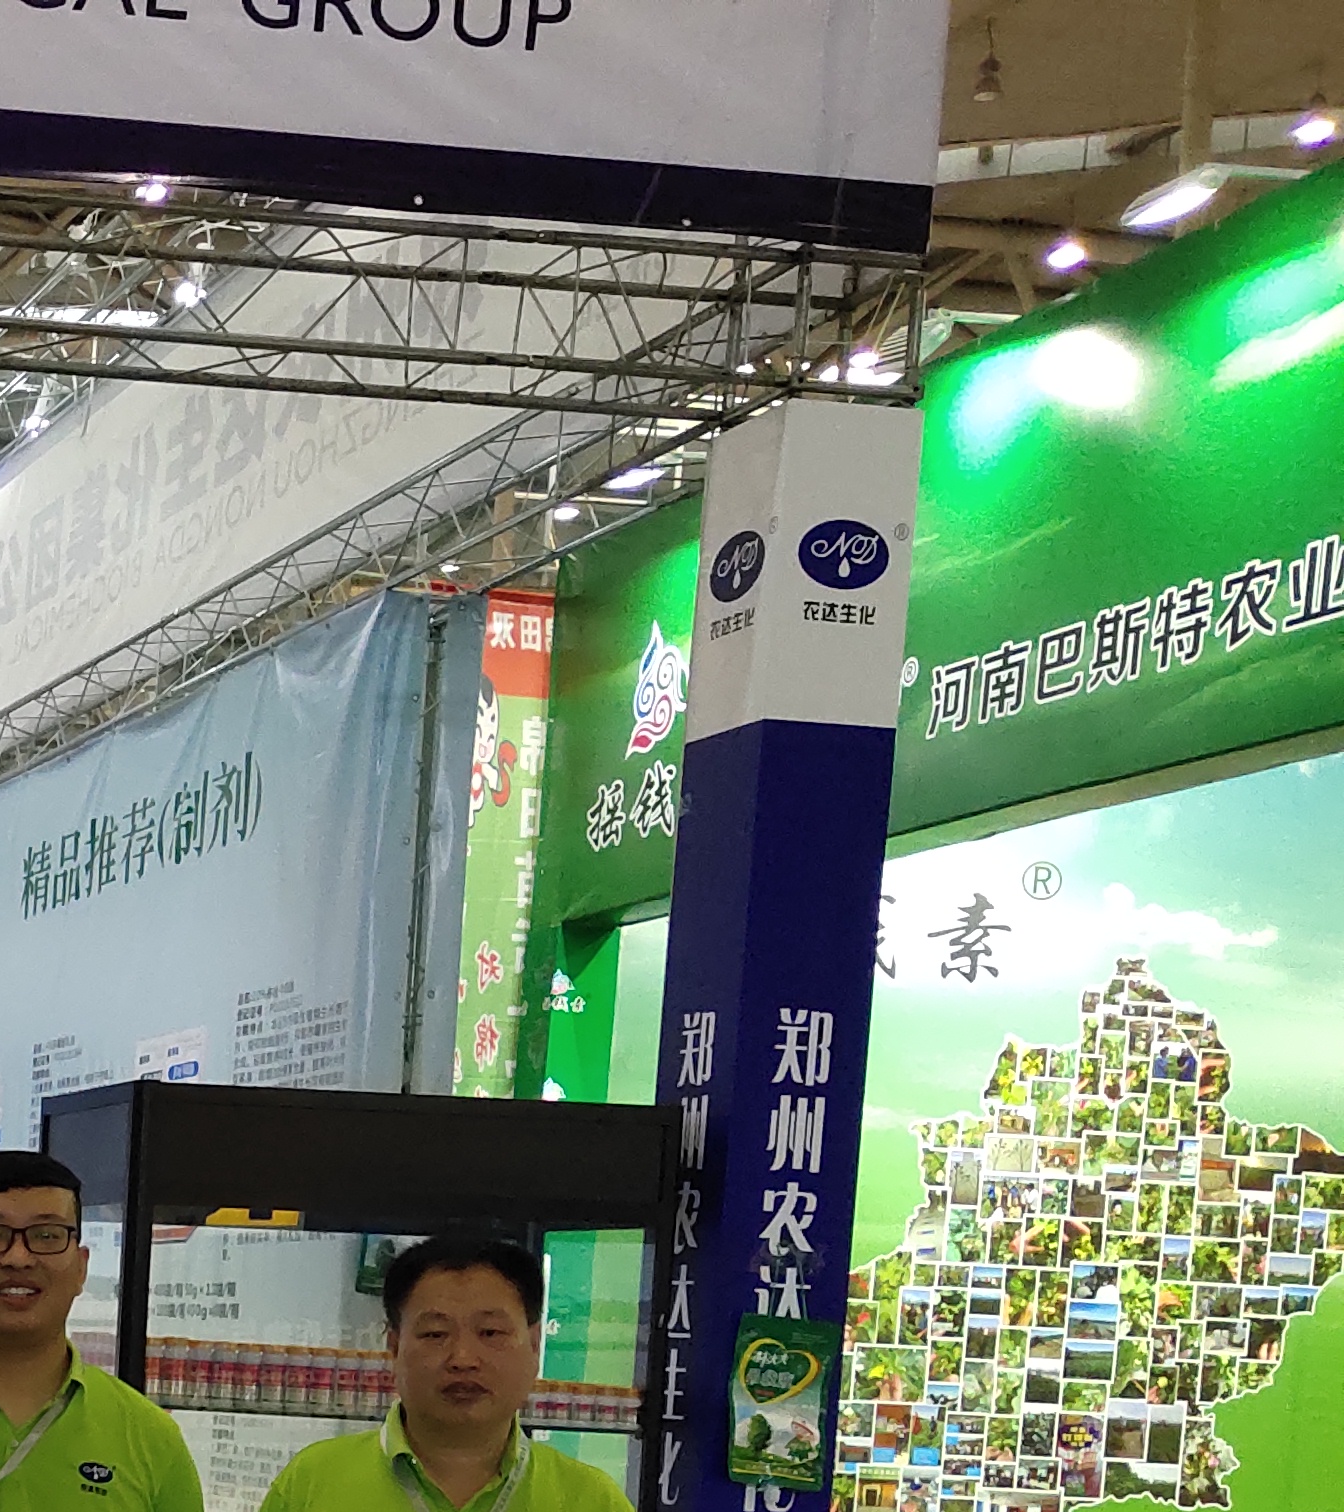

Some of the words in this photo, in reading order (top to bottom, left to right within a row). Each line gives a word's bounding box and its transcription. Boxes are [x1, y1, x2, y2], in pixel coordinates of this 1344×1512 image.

[710, 607, 756, 640] 农达生化
[803, 601, 876, 625] 农达生化
[925, 535, 1344, 740] 河南巴斯特农业
[19, 751, 263, 920] 精品推荐(制剂)
